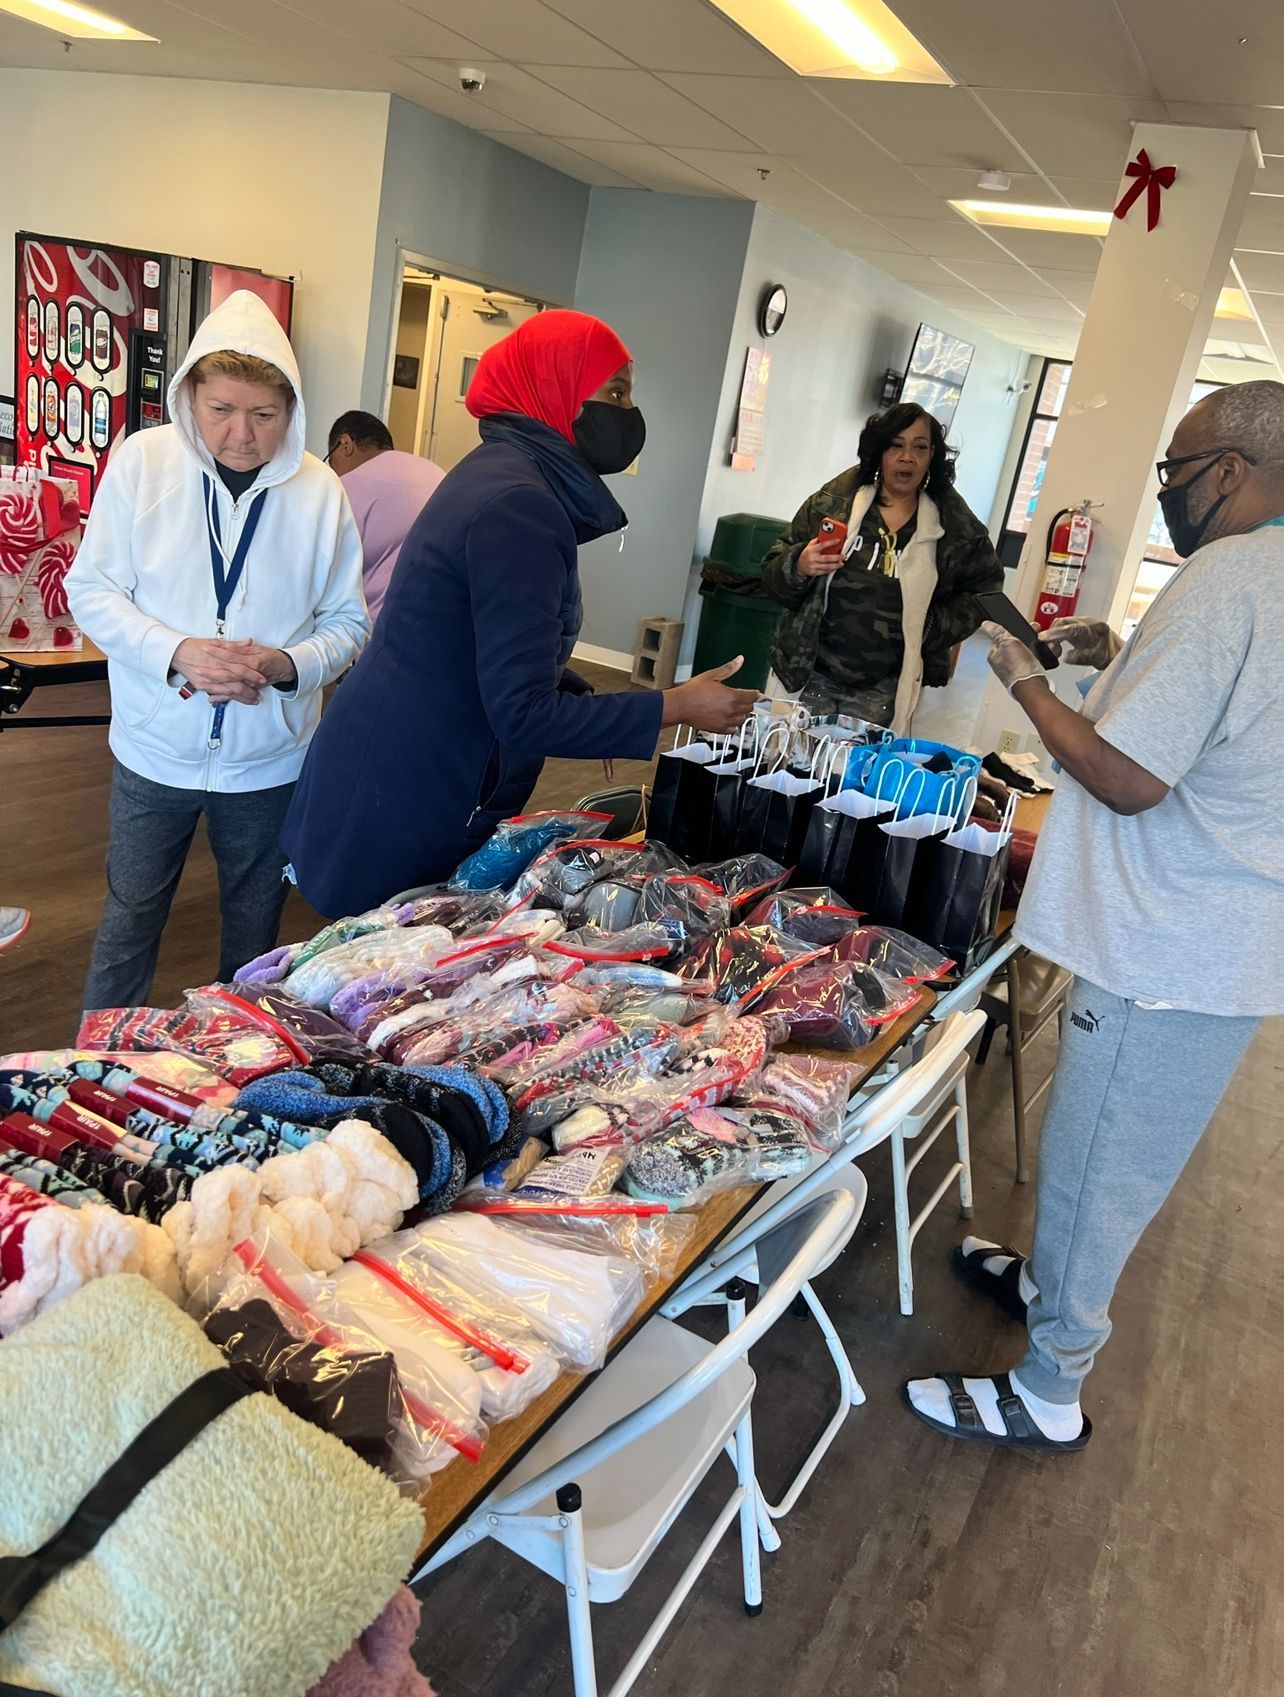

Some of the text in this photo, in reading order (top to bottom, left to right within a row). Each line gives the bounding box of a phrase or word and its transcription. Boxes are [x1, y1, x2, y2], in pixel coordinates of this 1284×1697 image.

[147, 346, 163, 357] Thank
[149, 356, 161, 364] You!
[1070, 1011, 1094, 1033] PUMA
